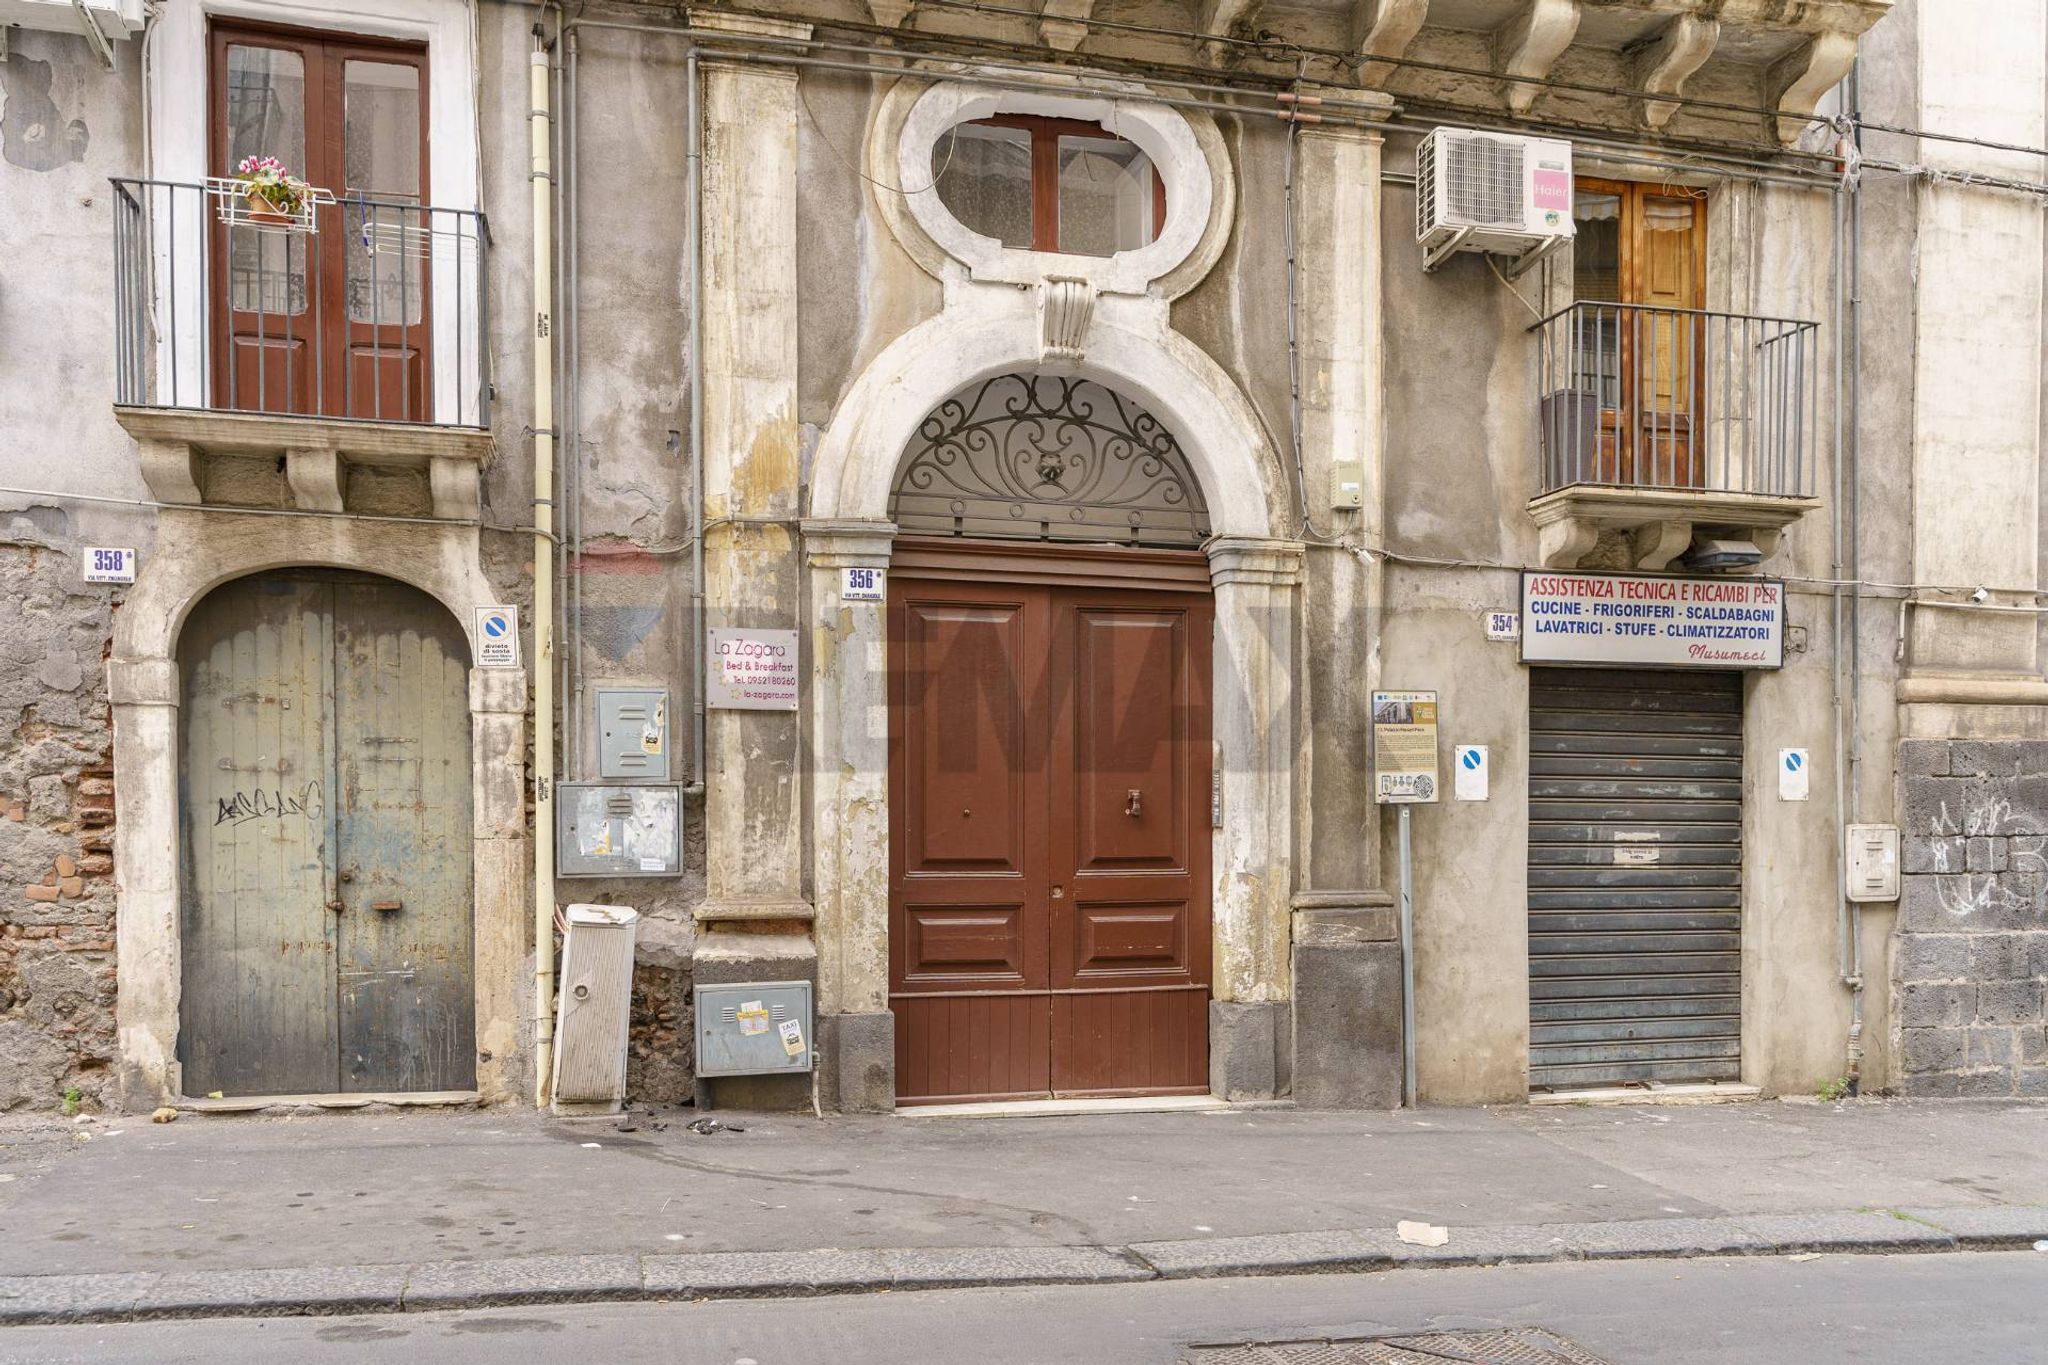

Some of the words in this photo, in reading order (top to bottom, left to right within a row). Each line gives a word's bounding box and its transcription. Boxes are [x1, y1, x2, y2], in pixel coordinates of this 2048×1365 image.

[94, 550, 123, 571] 358
[850, 570, 873, 588] 356
[1529, 577, 1614, 598] ASSISTENZA
[1619, 581, 1676, 600] TECNICA
[1681, 584, 1689, 600] E
[1692, 584, 1749, 603] RICAMBI
[1753, 587, 1778, 604] PER
[1531, 601, 1582, 615] CUCINE
[1593, 603, 1674, 618] FRIGORIFERI
[1686, 606, 1774, 622] SCALDABAGNI
[1492, 614, 1512, 632] 354
[1535, 619, 1603, 635] LAVATRICI
[1615, 622, 1656, 636] STUFE
[1667, 624, 1769, 640] CLIMATIZZATORI
[714, 638, 730, 655] La
[735, 638, 786, 659] Zagara
[1688, 644, 1766, 661] Musumeci
[726, 661, 742, 670] Bed
[745, 662, 751, 671] &
[754, 662, 793, 671] Breakfast
[747, 676, 796, 686] 0952180260
[743, 690, 795, 700] la-zagara.com
[782, 1021, 797, 1031] TAXI
